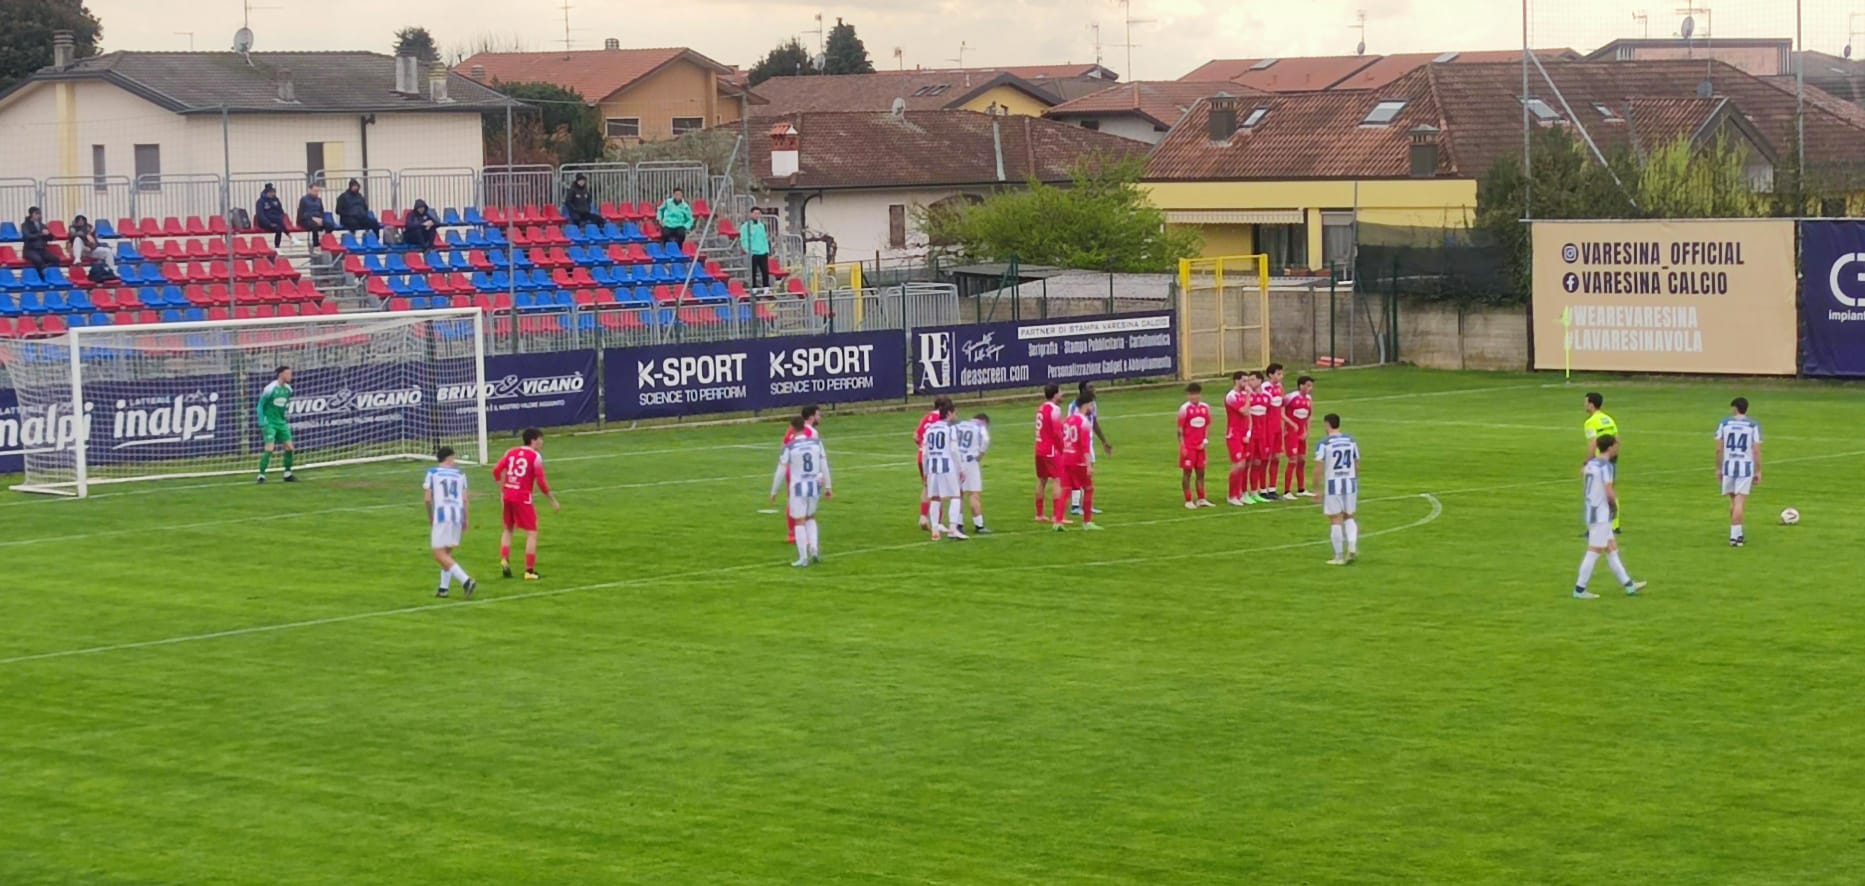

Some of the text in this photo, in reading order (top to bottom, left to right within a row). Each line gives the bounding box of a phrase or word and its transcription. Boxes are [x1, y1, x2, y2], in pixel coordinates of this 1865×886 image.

[1581, 241, 1744, 270] VARESINA_OFFICIAL
[1582, 271, 1728, 295] VARESINA CALCIO
[1020, 326, 1056, 337] PARTNER
[1058, 326, 1067, 334] DI
[1069, 323, 1100, 333] STAMPA
[1102, 320, 1140, 330] VARESINA
[1064, 340, 1088, 354] Stampa
[638, 353, 748, 390] K-SPORT
[769, 344, 874, 378] K-SPORT
[436, 384, 495, 401] BRIVO
[522, 371, 585, 393] VIGANÒ
[770, 376, 874, 395] SCIENCE TO PERFORM
[961, 364, 1030, 387] deascreen.com
[286, 397, 327, 414] IVIO
[639, 385, 747, 406] SCIENCE TO PERFORM
[113, 392, 219, 441] inalpi
[927, 430, 946, 451] 90
[1063, 422, 1079, 443] 90
[1726, 432, 1748, 453] 44
[506, 455, 528, 477] 13
[802, 452, 813, 472] 8
[1332, 449, 1352, 470] 24
[440, 478, 458, 498] 14
